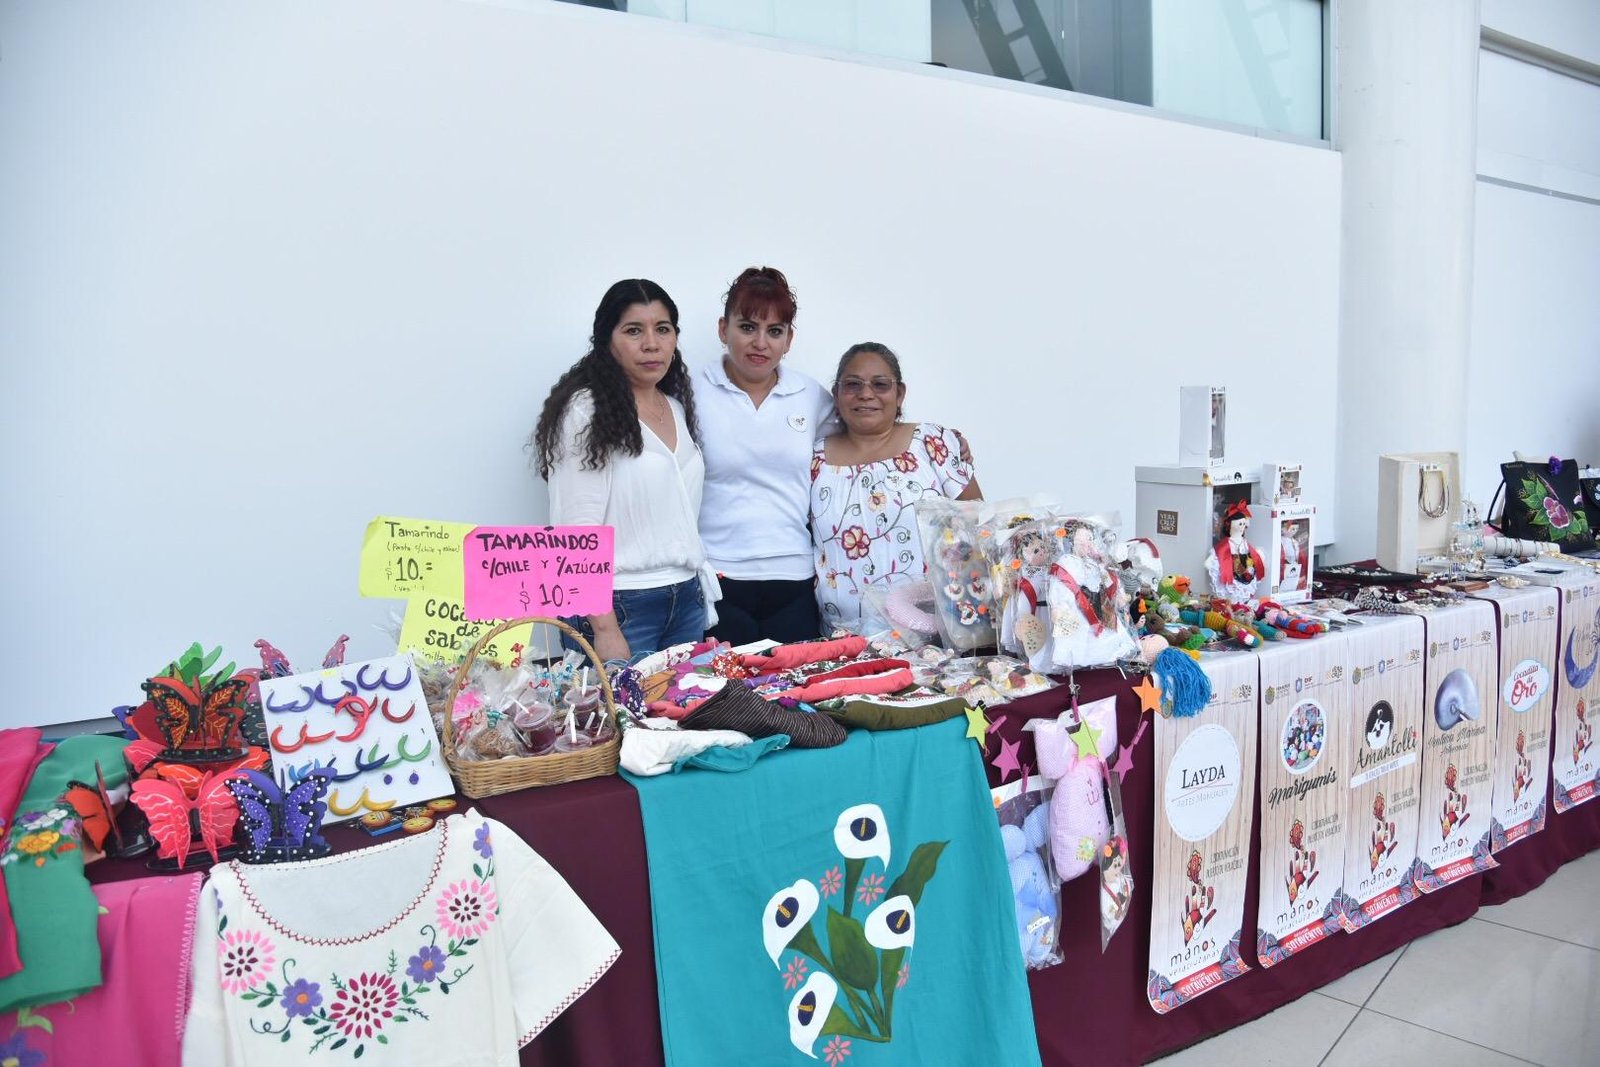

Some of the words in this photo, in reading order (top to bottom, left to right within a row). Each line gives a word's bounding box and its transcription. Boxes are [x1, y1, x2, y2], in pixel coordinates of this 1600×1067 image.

[385, 521, 450, 540] Tamarindo
[520, 581, 531, 611] $
[456, 623, 480, 638] de
[1181, 764, 1226, 789] LAYDA
[1431, 838, 1469, 857] manos
[1359, 865, 1398, 891] manos
[1276, 897, 1320, 925] manos
[1285, 926, 1324, 952] SOTAVENTO
[1170, 937, 1216, 968] manos
[1181, 971, 1222, 998] SOTAVENTO
